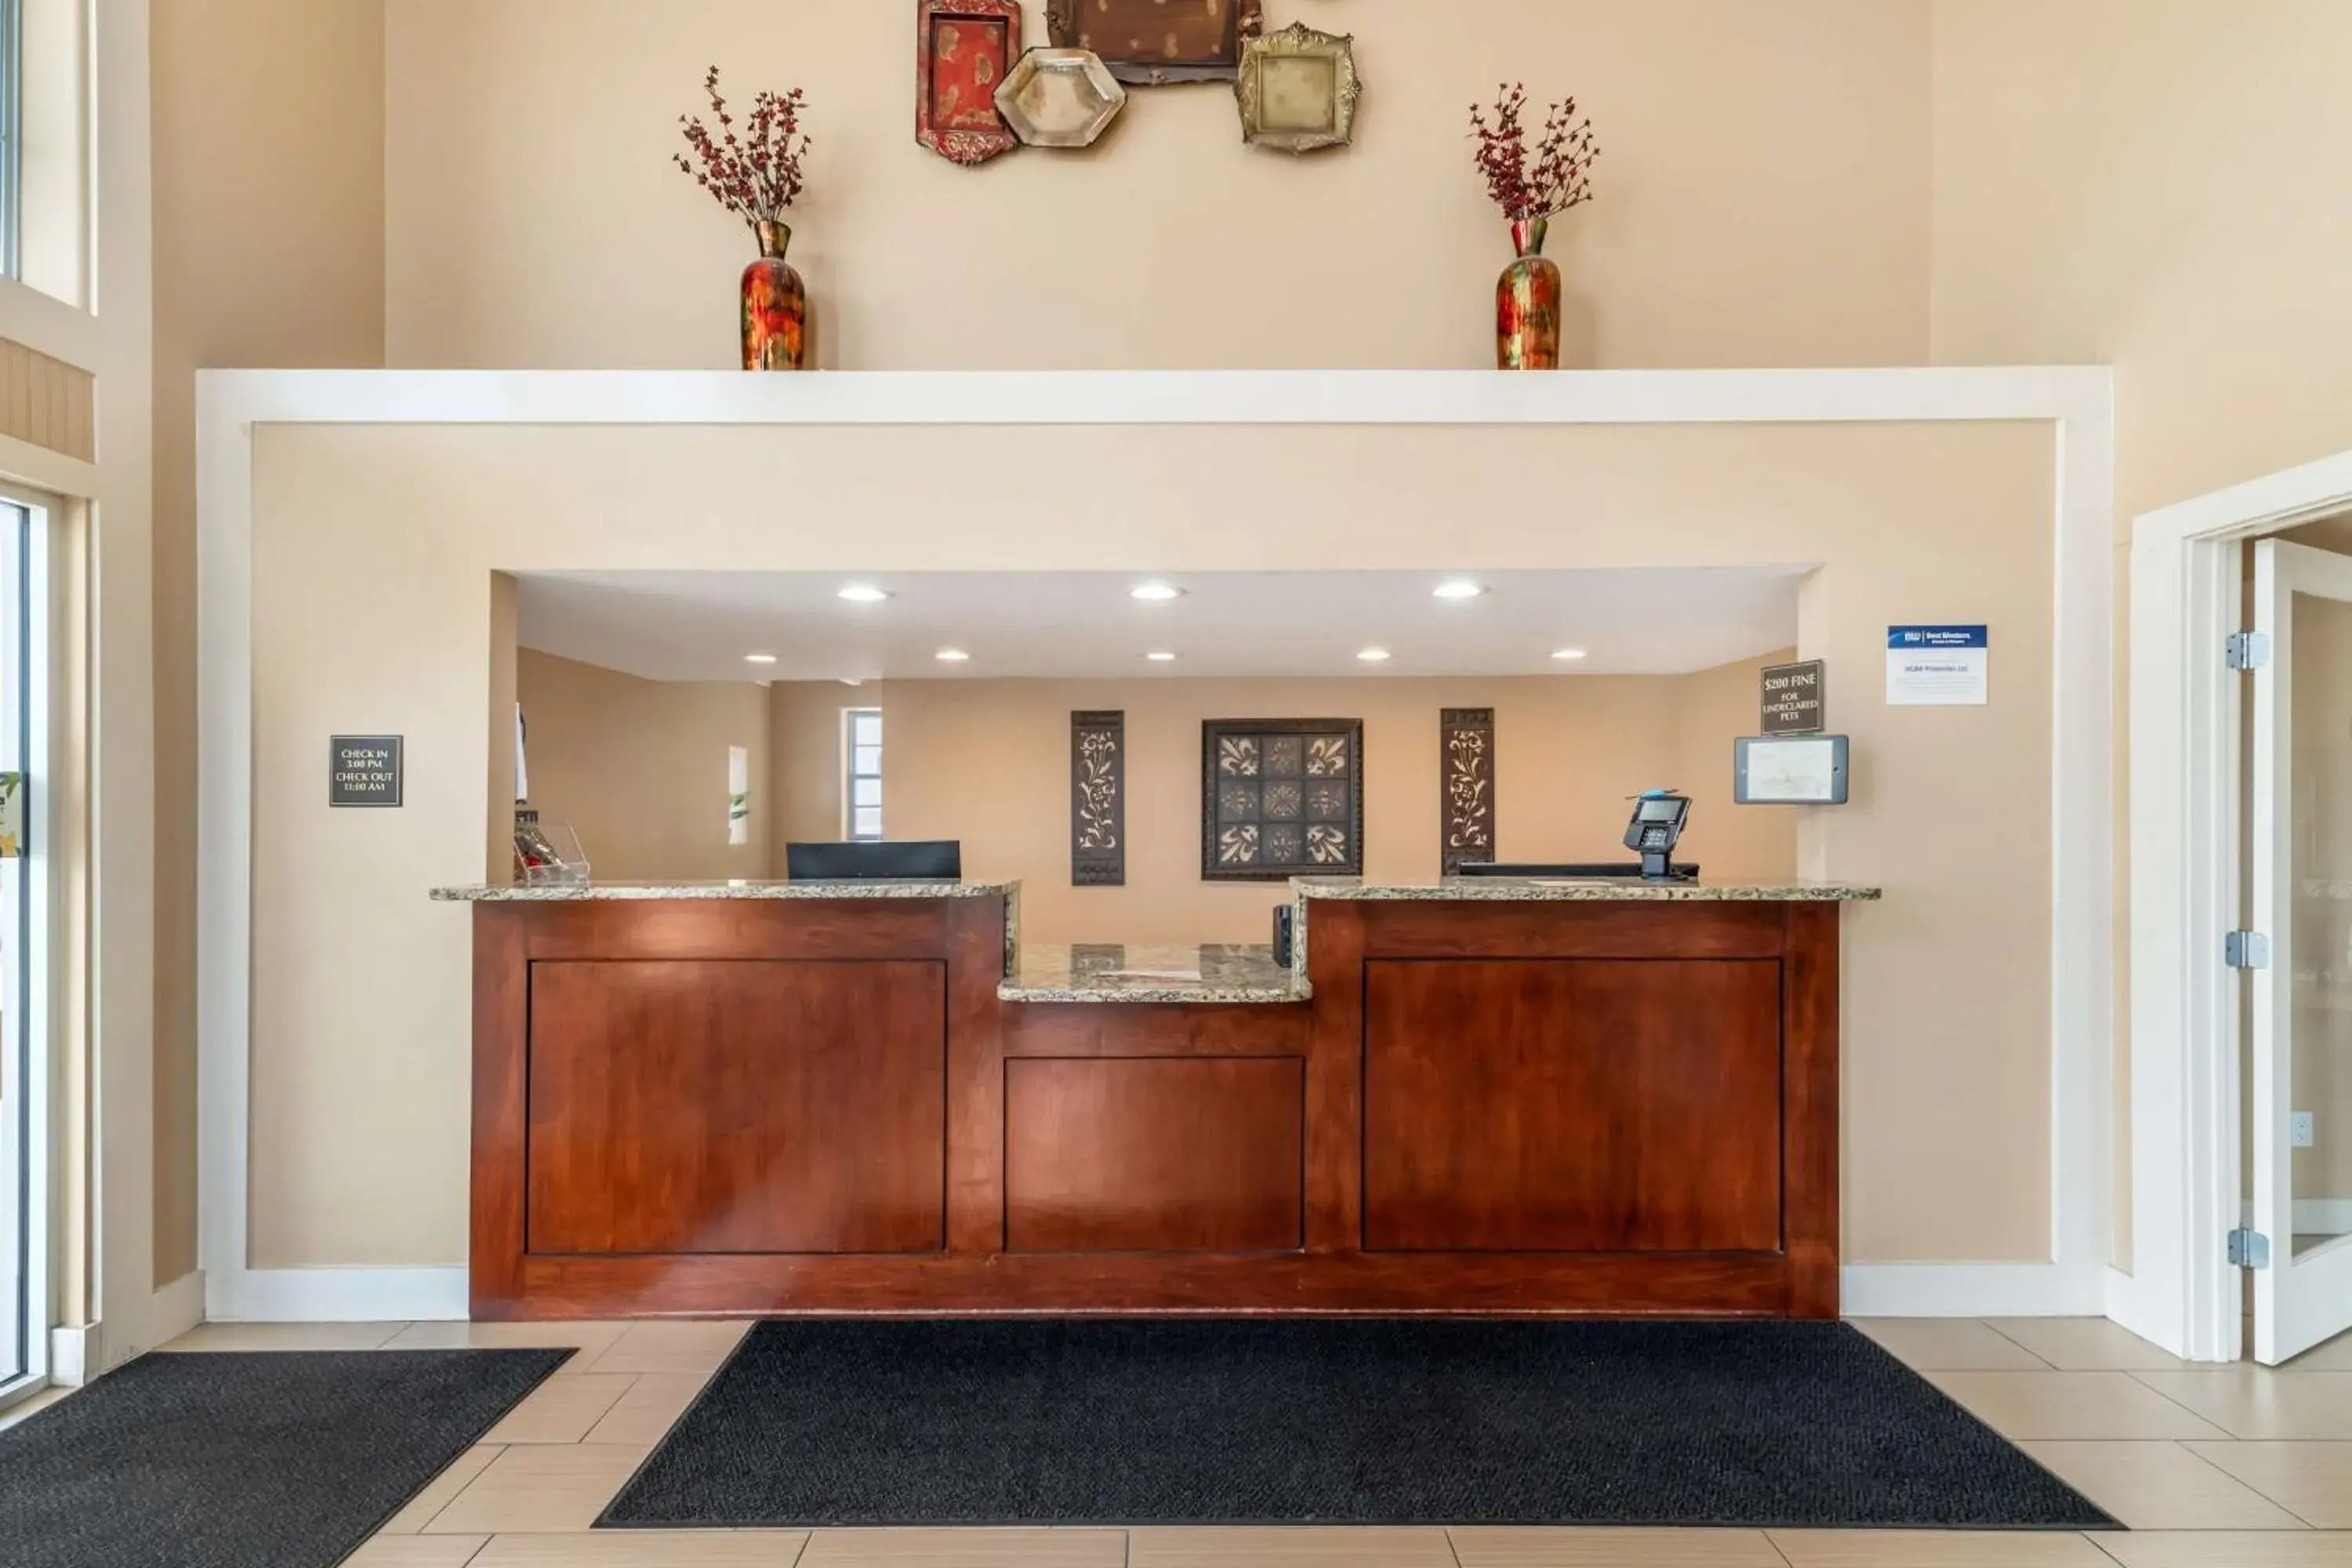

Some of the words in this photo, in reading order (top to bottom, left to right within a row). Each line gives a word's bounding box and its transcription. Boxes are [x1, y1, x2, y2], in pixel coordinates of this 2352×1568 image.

[1764, 679, 1788, 691] $200
[1791, 673, 1817, 686] FINE
[1780, 692, 1798, 702] FOR
[1763, 700, 1818, 713] UNDECLARED
[1780, 711, 1799, 721] PETS
[341, 749, 374, 758] CHECK
[376, 750, 388, 758] IN
[347, 760, 365, 768] 3:00
[368, 760, 383, 768] PM
[336, 772, 368, 782] CHECK
[371, 772, 394, 782] OUT
[344, 782, 366, 791] 11:00
[368, 782, 385, 791] AM
